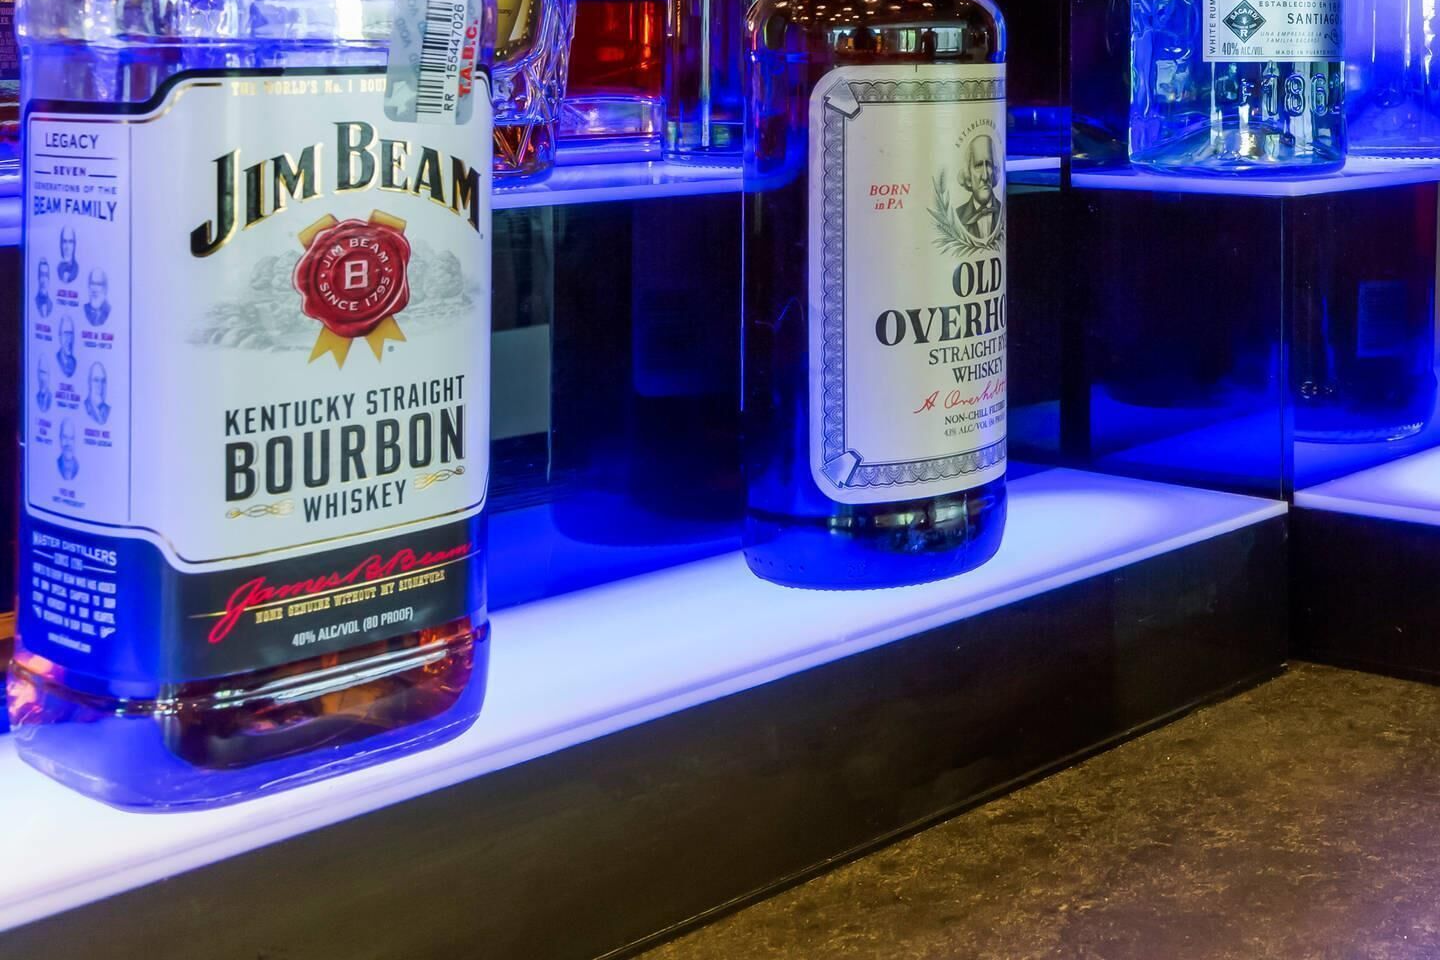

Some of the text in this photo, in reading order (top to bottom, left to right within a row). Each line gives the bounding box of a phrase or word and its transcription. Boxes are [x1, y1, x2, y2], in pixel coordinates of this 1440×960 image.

[444, 3, 464, 111] RR 155447026
[459, 19, 478, 97] T.A.B.C.
[1222, 42, 1264, 55] 40% ALC/VOL
[45, 133, 98, 149] LEGACY
[53, 165, 87, 177] SEVEN
[84, 185, 94, 193] OF
[99, 186, 117, 195] THE
[190, 120, 481, 258] JIM BEAM
[869, 184, 911, 196] BORN
[34, 195, 117, 221] BEAM FAMILY
[875, 198, 904, 210] in PA
[323, 238, 389, 267] JIM BEAM
[344, 260, 368, 289] B
[952, 257, 1002, 298] OLD
[320, 276, 390, 311] SINCE 1795
[875, 293, 1006, 346] OVERHO
[928, 337, 998, 365] STRAIGHT
[952, 356, 1003, 384] WHISKEY
[225, 375, 465, 436] KENTUCKY STRAIGHT
[913, 390, 940, 414] A
[225, 404, 465, 502] BOURBON
[303, 479, 407, 523] WHISKEY
[62, 540, 117, 566] DISTILLERS
[208, 577, 345, 644] James
[382, 543, 472, 573] Beam
[287, 596, 331, 617] GENUINE
[333, 587, 378, 608] WITHOUT
[379, 583, 396, 597] MY
[398, 570, 446, 592] SIGNATURE
[291, 606, 414, 647] 40% ALC/VOL (80 PROOF)
